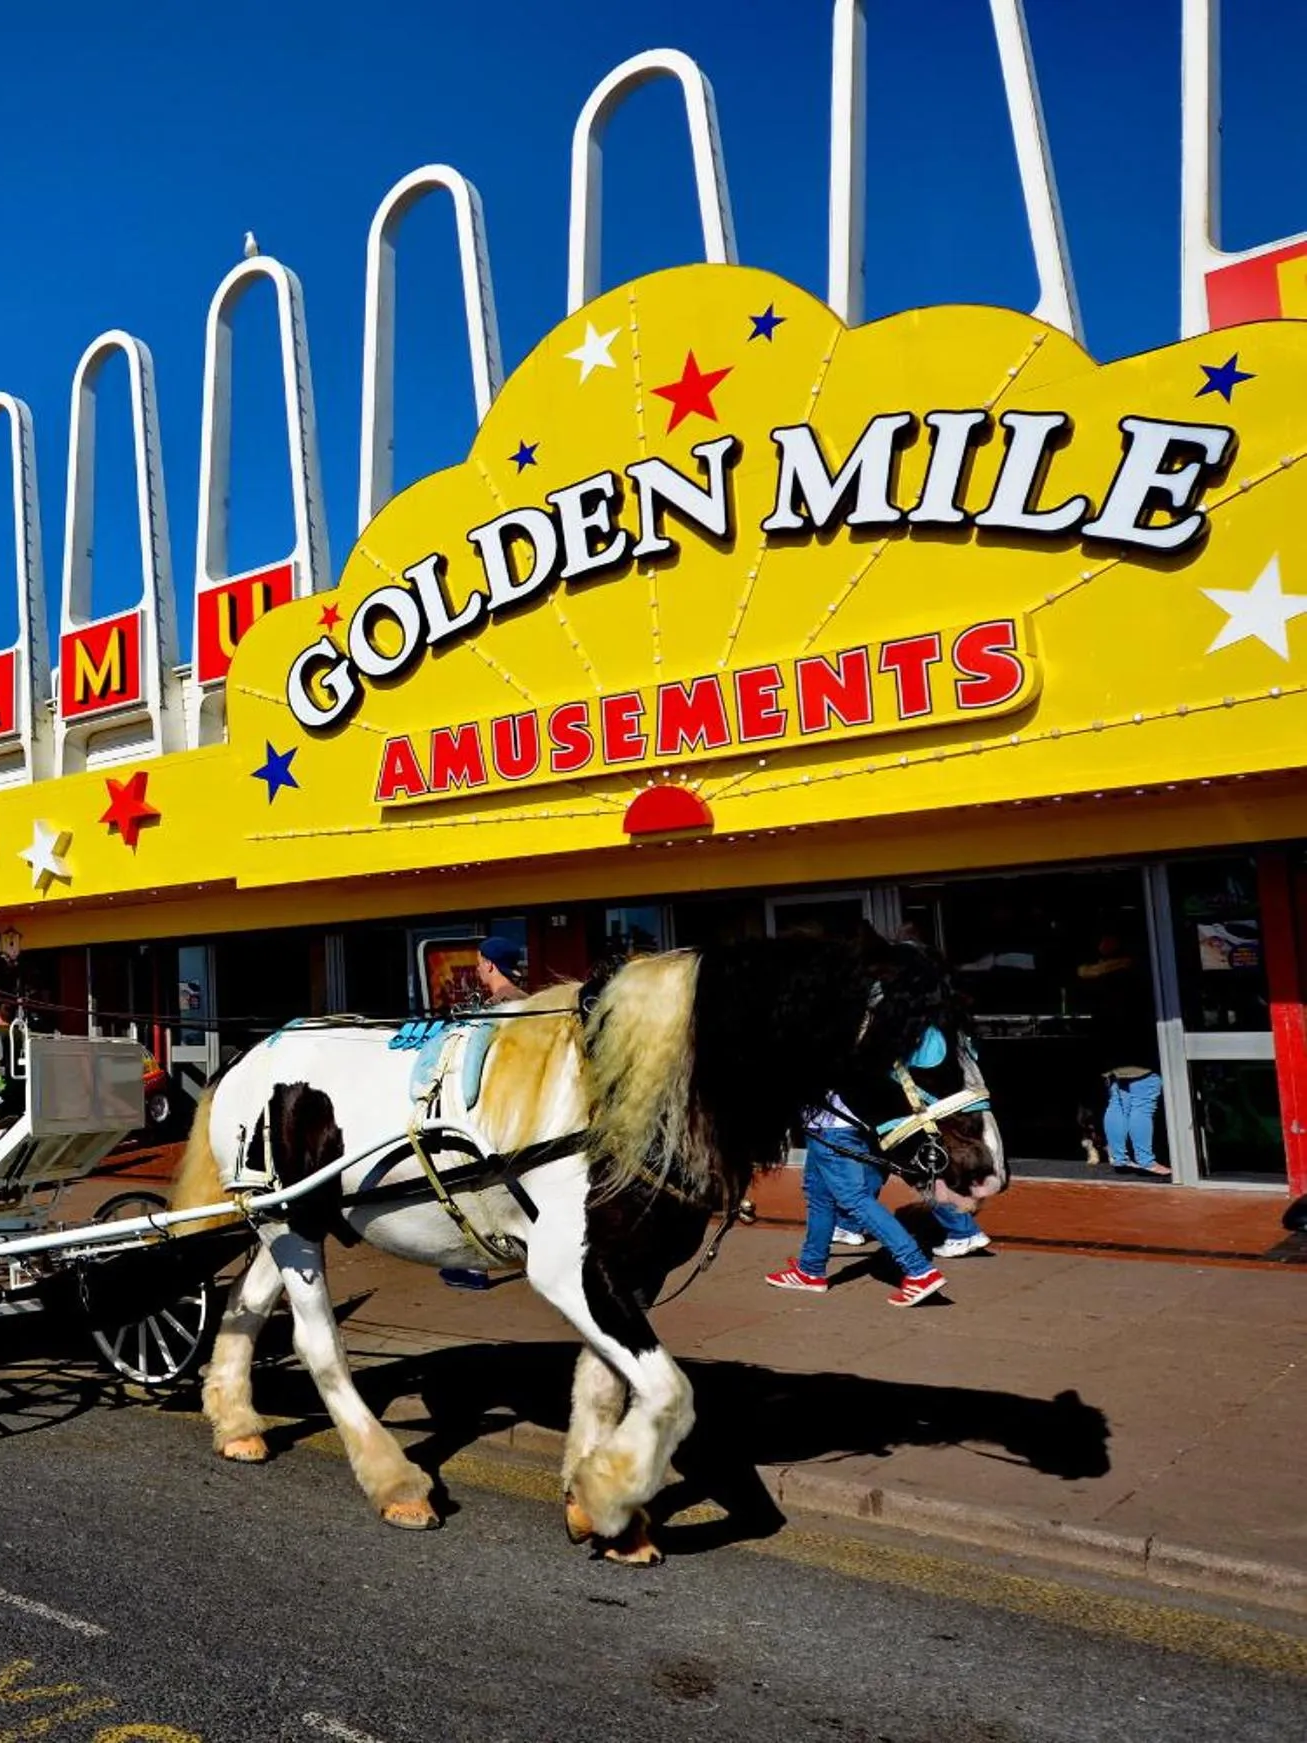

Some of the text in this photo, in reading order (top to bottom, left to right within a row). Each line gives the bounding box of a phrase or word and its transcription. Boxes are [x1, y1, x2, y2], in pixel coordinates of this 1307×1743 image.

[285, 408, 1238, 731] GOLDEN MILE
[375, 617, 1028, 804] AMUSEMENTS
